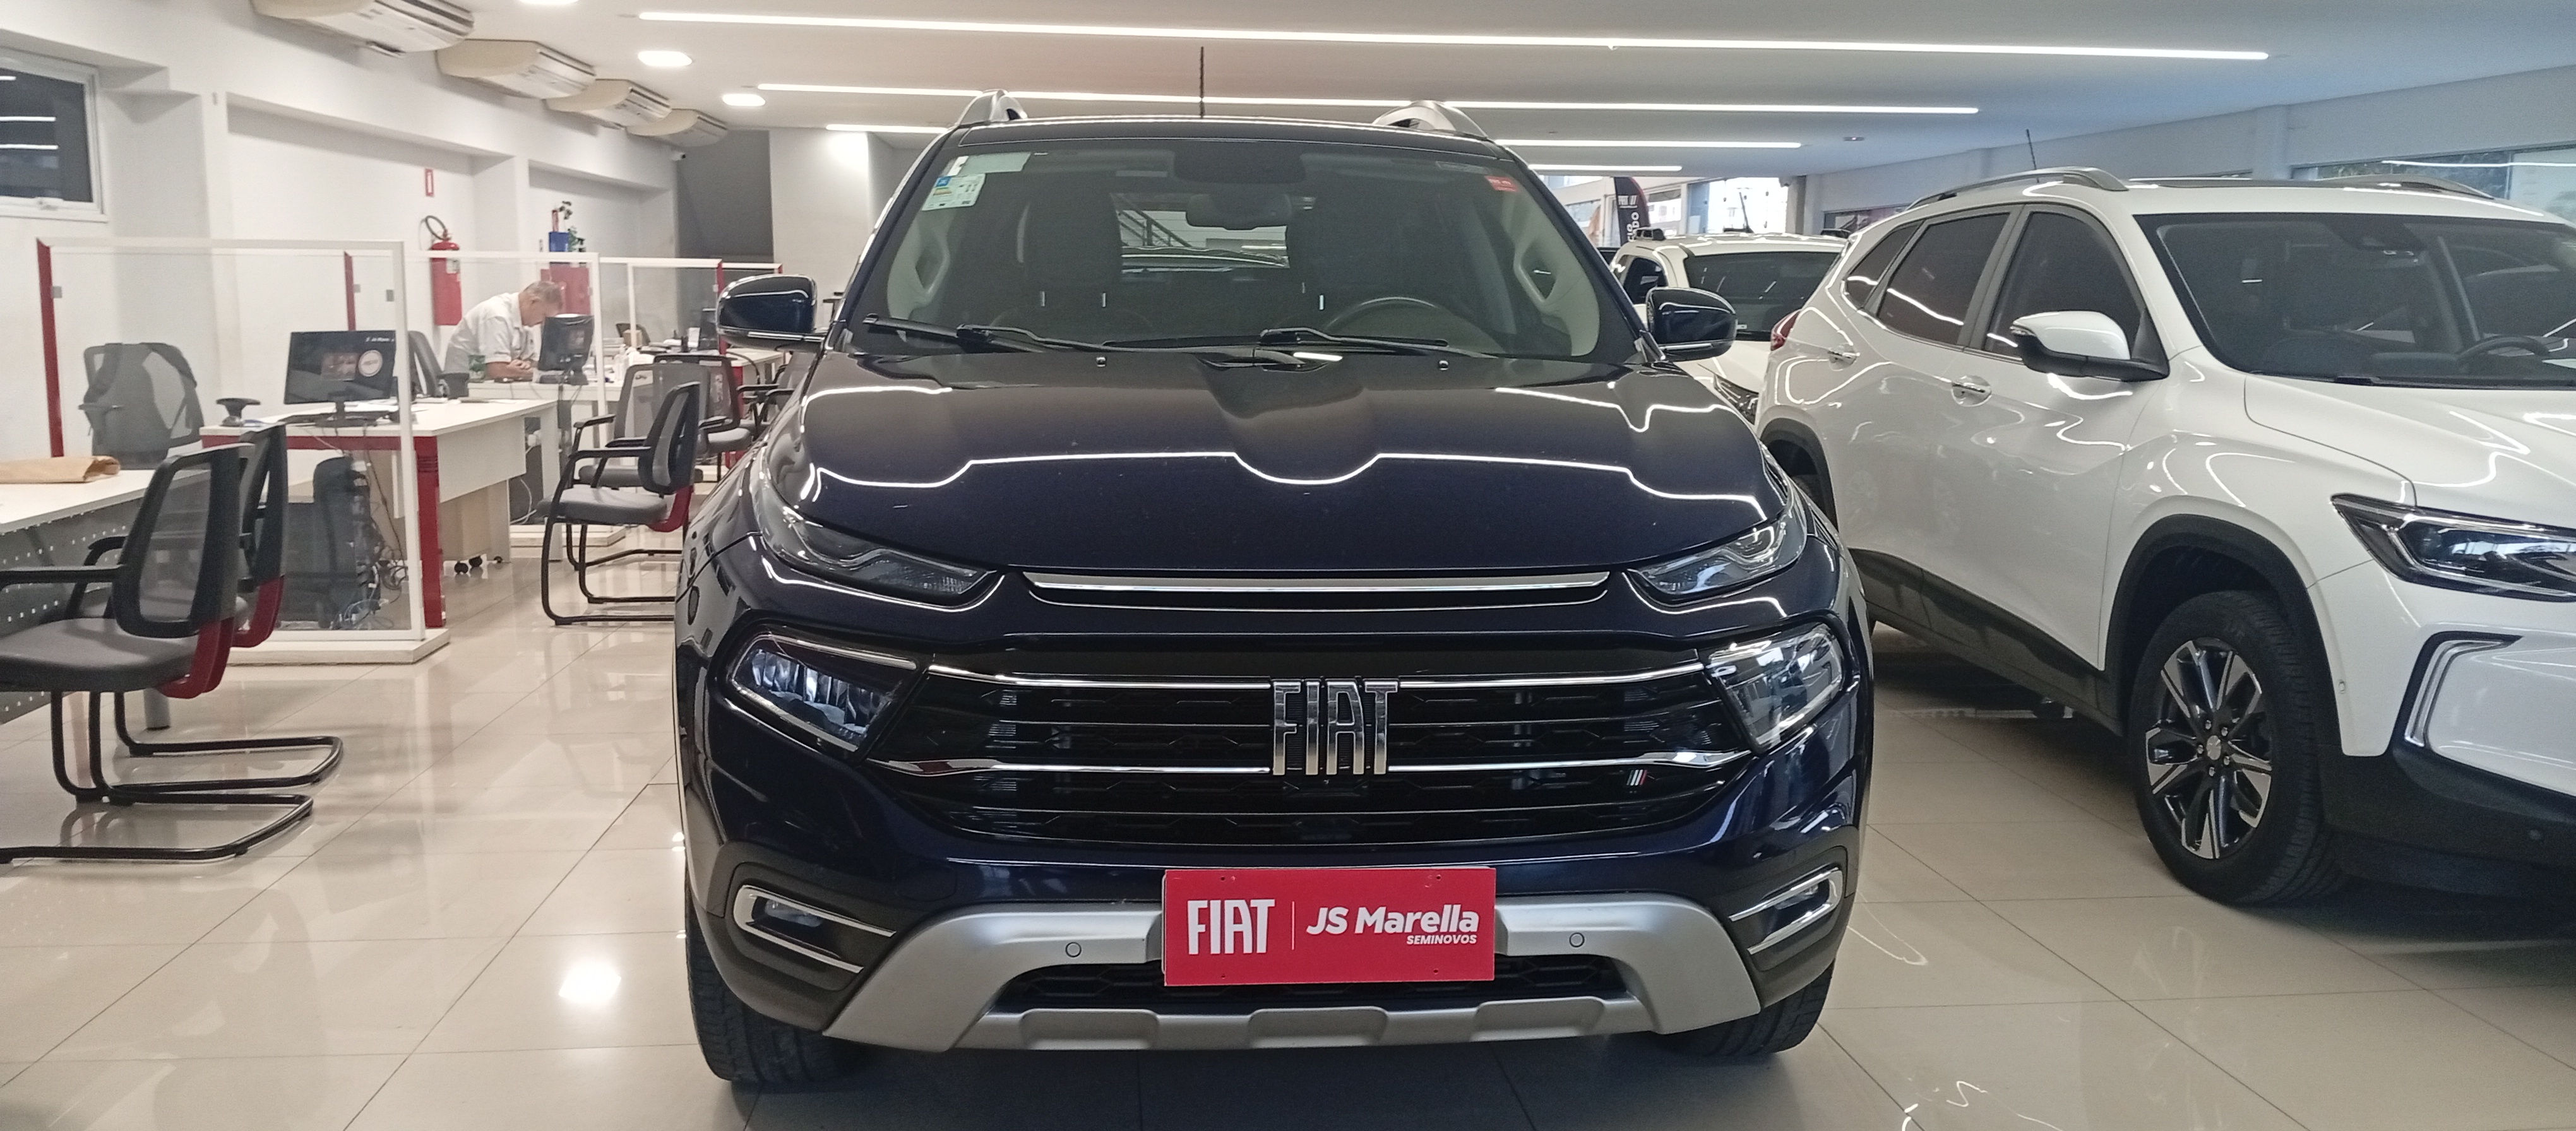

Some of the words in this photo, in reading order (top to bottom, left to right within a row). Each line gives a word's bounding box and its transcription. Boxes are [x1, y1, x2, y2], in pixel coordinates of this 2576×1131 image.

[1272, 681, 1398, 776] FIAT
[1187, 899, 1275, 954] FIAT
[1306, 906, 1349, 935] JS
[1354, 904, 1479, 934] Marella
[1406, 935, 1477, 945] SEMINOVOS
